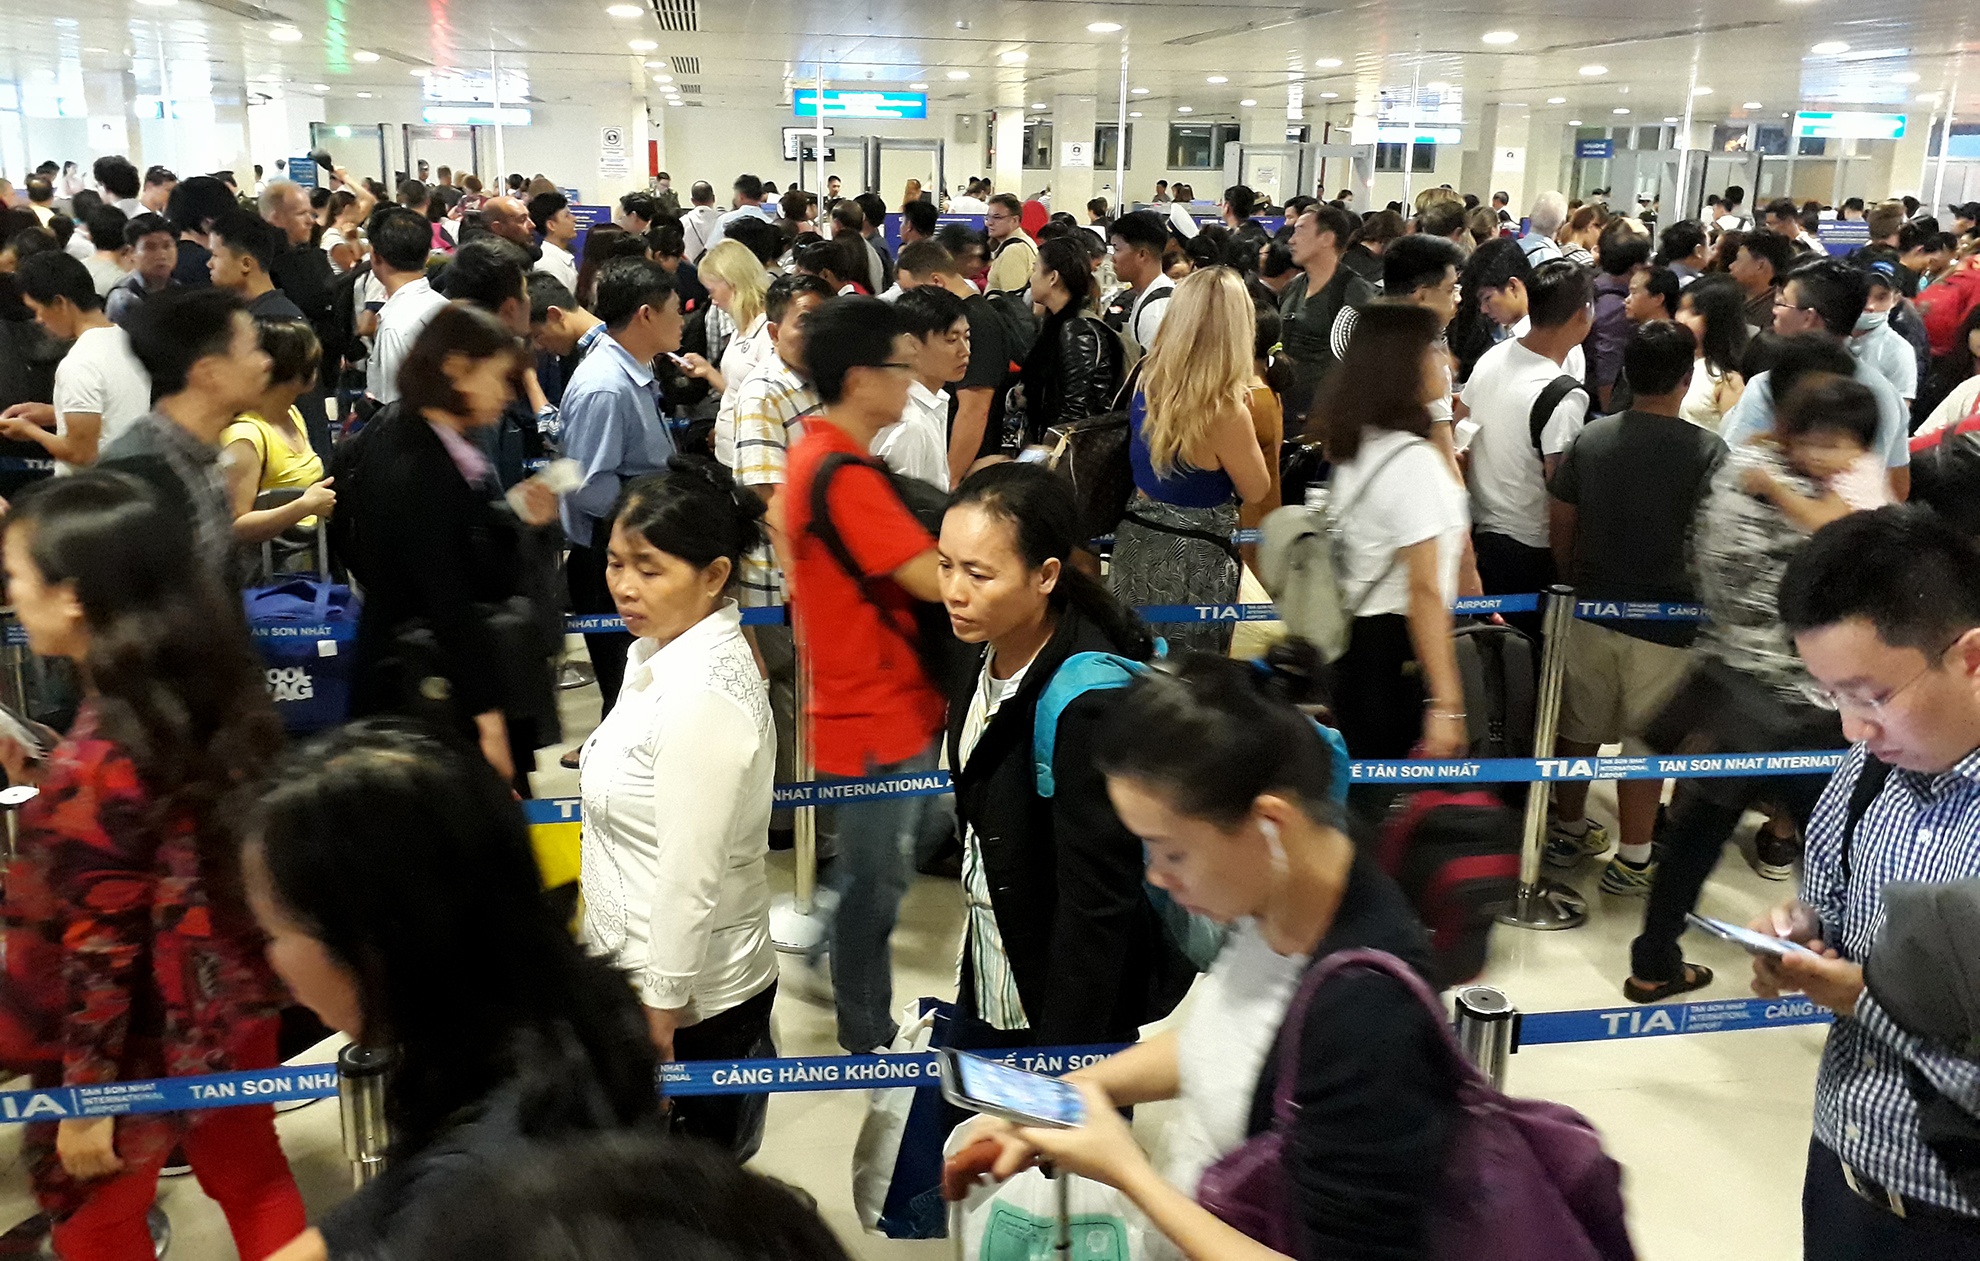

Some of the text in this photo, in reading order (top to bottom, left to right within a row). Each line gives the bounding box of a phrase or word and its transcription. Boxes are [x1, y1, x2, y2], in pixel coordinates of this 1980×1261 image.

[1455, 599, 1502, 610] AIRPORT
[1578, 602, 1620, 617] TIA
[1194, 607, 1239, 620] TIA
[300, 624, 331, 635] NHẤT
[567, 619, 599, 629] NHAT
[1366, 763, 1397, 778] TÂN
[1400, 765, 1434, 778] SƠN
[1437, 761, 1481, 777] NHẤT
[1535, 759, 1594, 778] TIA
[1658, 760, 1688, 773] TAN
[1690, 759, 1723, 771] SON
[1724, 757, 1766, 770] NHAT
[772, 787, 813, 801] NHAT
[817, 776, 944, 800] INTERNATIONAL
[1688, 1011, 1751, 1022] INTERNATIONAL
[1764, 999, 1814, 1020] CẢNG
[1600, 1009, 1676, 1036] TIA
[660, 1064, 687, 1072] NHAT
[712, 1063, 773, 1086] CẢNG
[778, 1062, 843, 1083] HÀNG
[845, 1058, 920, 1081] KHÔNG
[1022, 1052, 1063, 1072] TÂN
[80, 1088, 102, 1097] TAN
[103, 1086, 127, 1095] SON
[189, 1082, 236, 1100] TAN
[241, 1077, 293, 1097] SON
[2, 1093, 68, 1119] IA
[81, 1092, 164, 1106] INTERNATIONAL
[84, 1103, 131, 1115] AIRPORT
